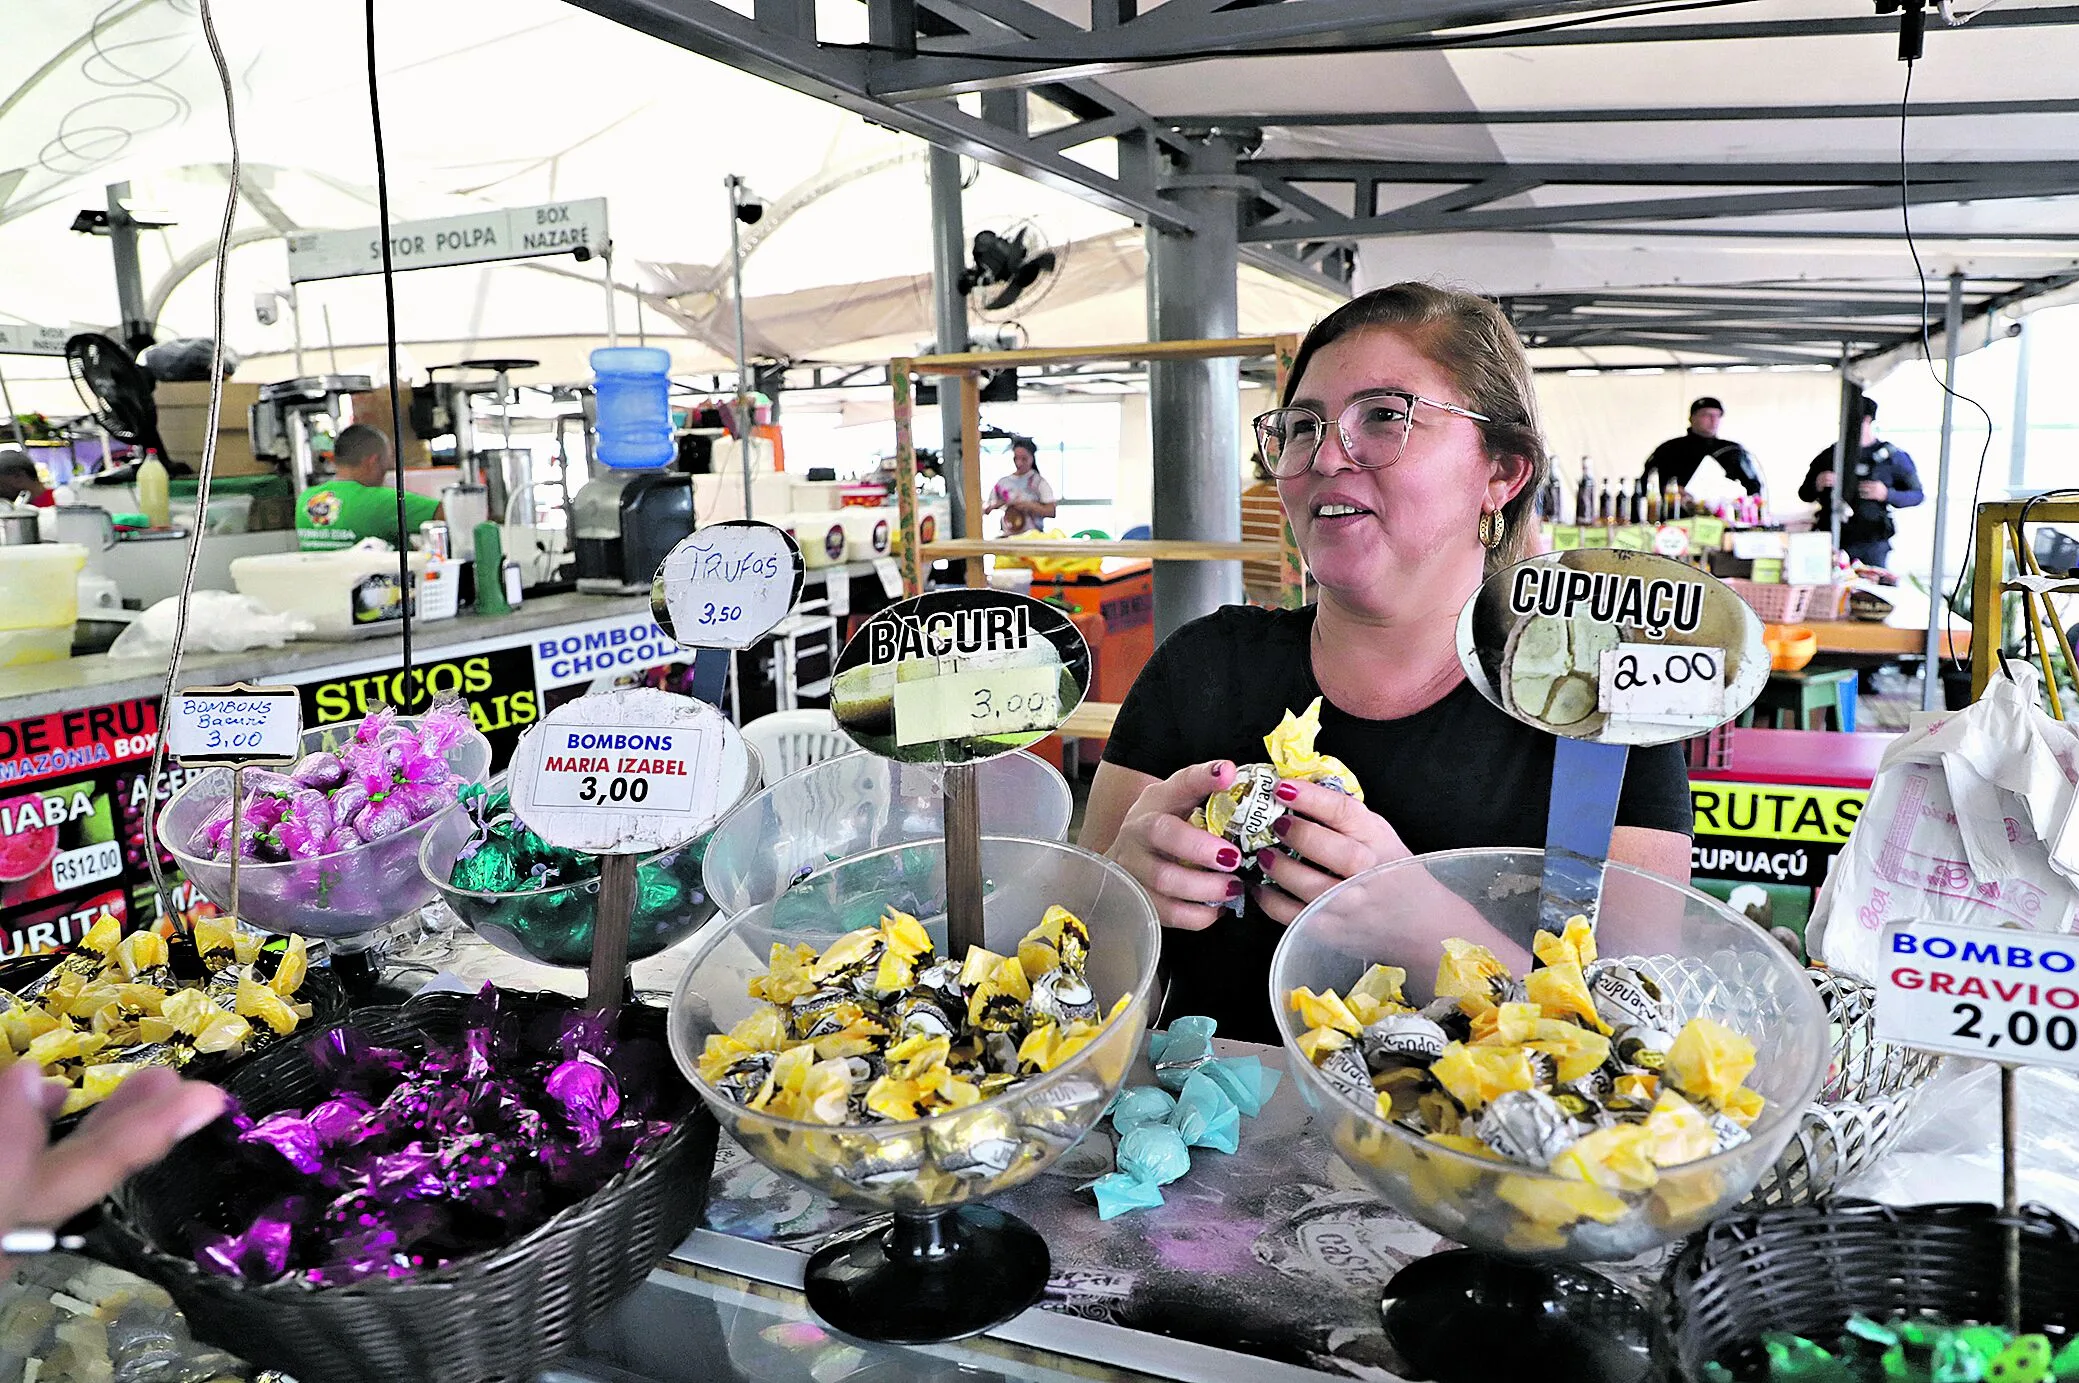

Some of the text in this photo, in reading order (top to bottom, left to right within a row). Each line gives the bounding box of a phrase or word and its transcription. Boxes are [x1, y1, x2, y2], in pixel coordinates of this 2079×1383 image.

[536, 206, 569, 225] BOX
[370, 226, 497, 259] STOR POLPA
[523, 226, 589, 250] NAZARÉ
[699, 602, 742, 625] 3,50
[1511, 566, 1703, 639] CUPUAÇU
[869, 606, 1029, 665] BACURI
[316, 657, 493, 723] SUCOS
[183, 700, 272, 715] BOMBONS
[567, 733, 673, 751] BOMBONS
[545, 756, 688, 776] MARIA IZABEL
[579, 776, 649, 806] 3,00
[1893, 933, 2076, 973] BOMBO
[1891, 967, 2079, 1010] GRAVIO
[1952, 1003, 2077, 1051] 2,00
